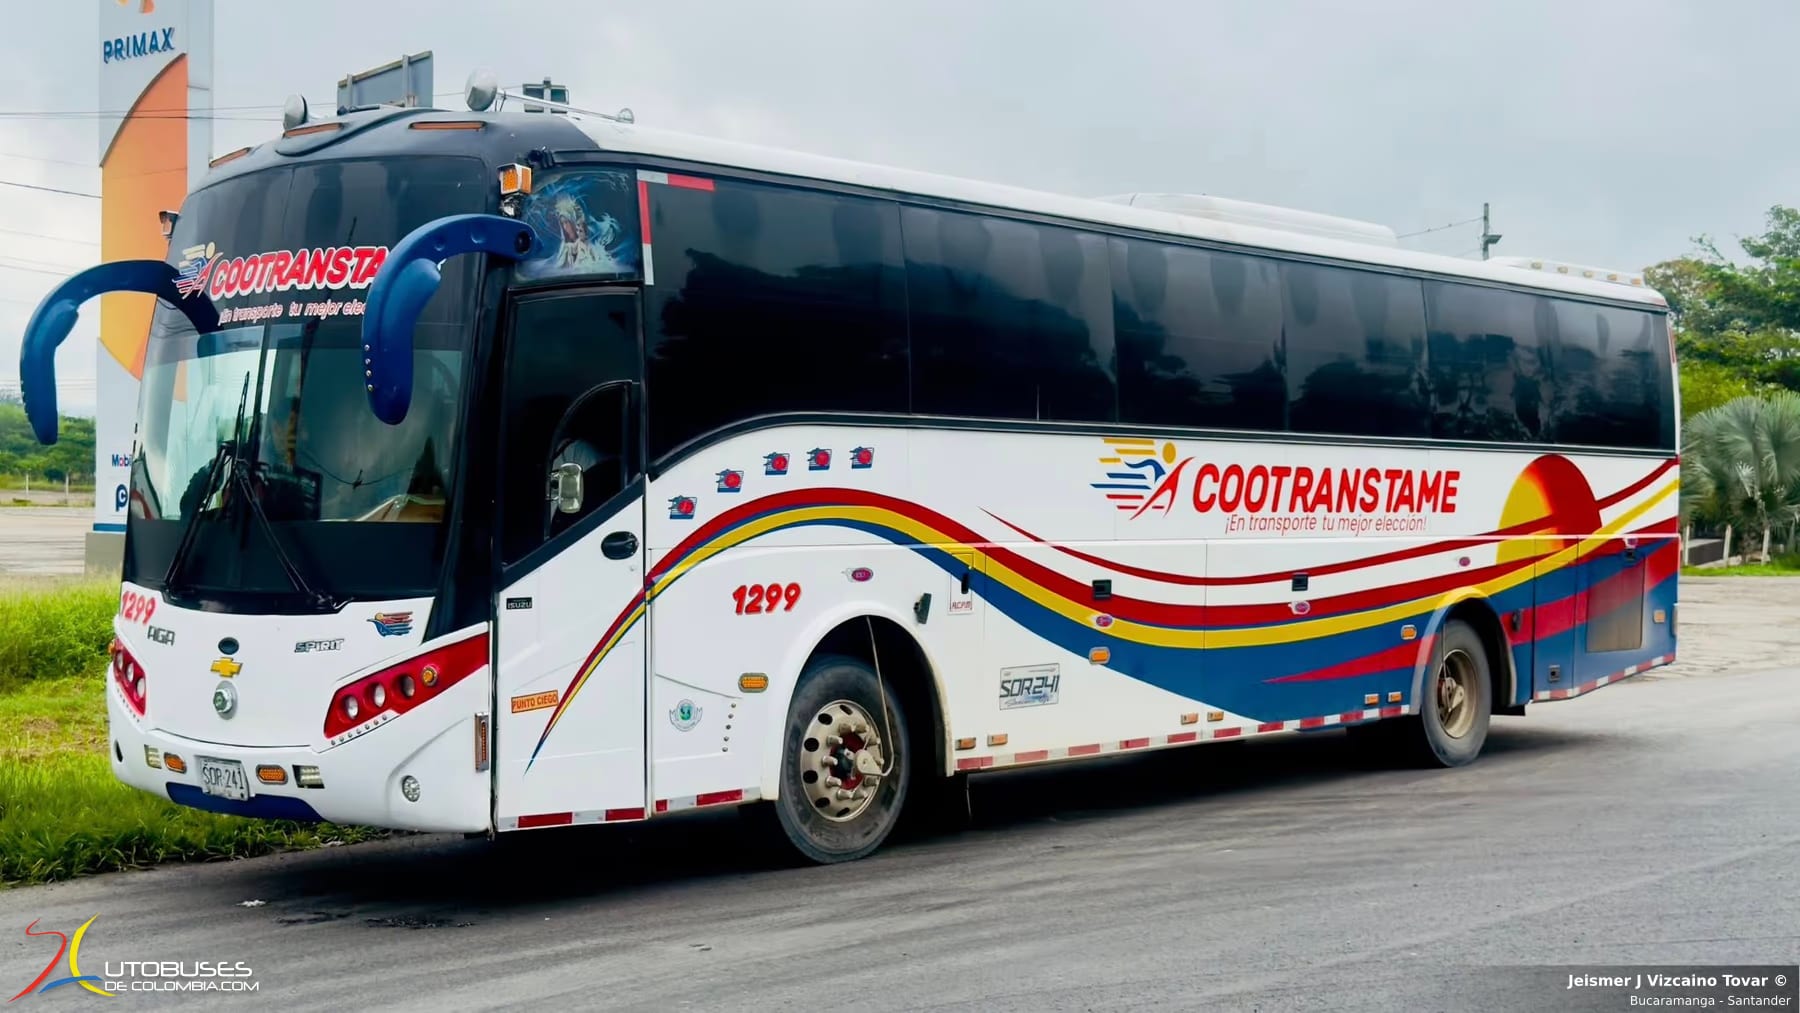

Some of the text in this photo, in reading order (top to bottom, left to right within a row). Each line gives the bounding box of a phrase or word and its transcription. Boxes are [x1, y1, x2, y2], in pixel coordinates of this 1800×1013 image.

[103, 26, 175, 64] PRIMAX
[209, 246, 391, 301] COOTRANSTA
[232, 302, 284, 324] transporte
[288, 301, 303, 317] tu
[304, 298, 344, 320] mejor
[1193, 463, 1461, 514] COOTRANSTAME
[1248, 514, 1317, 536] transporte
[1322, 515, 1334, 531] tu
[1337, 515, 1373, 537] mejor
[1375, 514, 1427, 532] elección!
[122, 591, 156, 625] 1299
[507, 601, 532, 609] ISUZU
[732, 582, 802, 616] 1299
[147, 625, 175, 646] AGA
[294, 638, 344, 653] SPIRIT
[512, 693, 558, 712] PUNTO CIEGO
